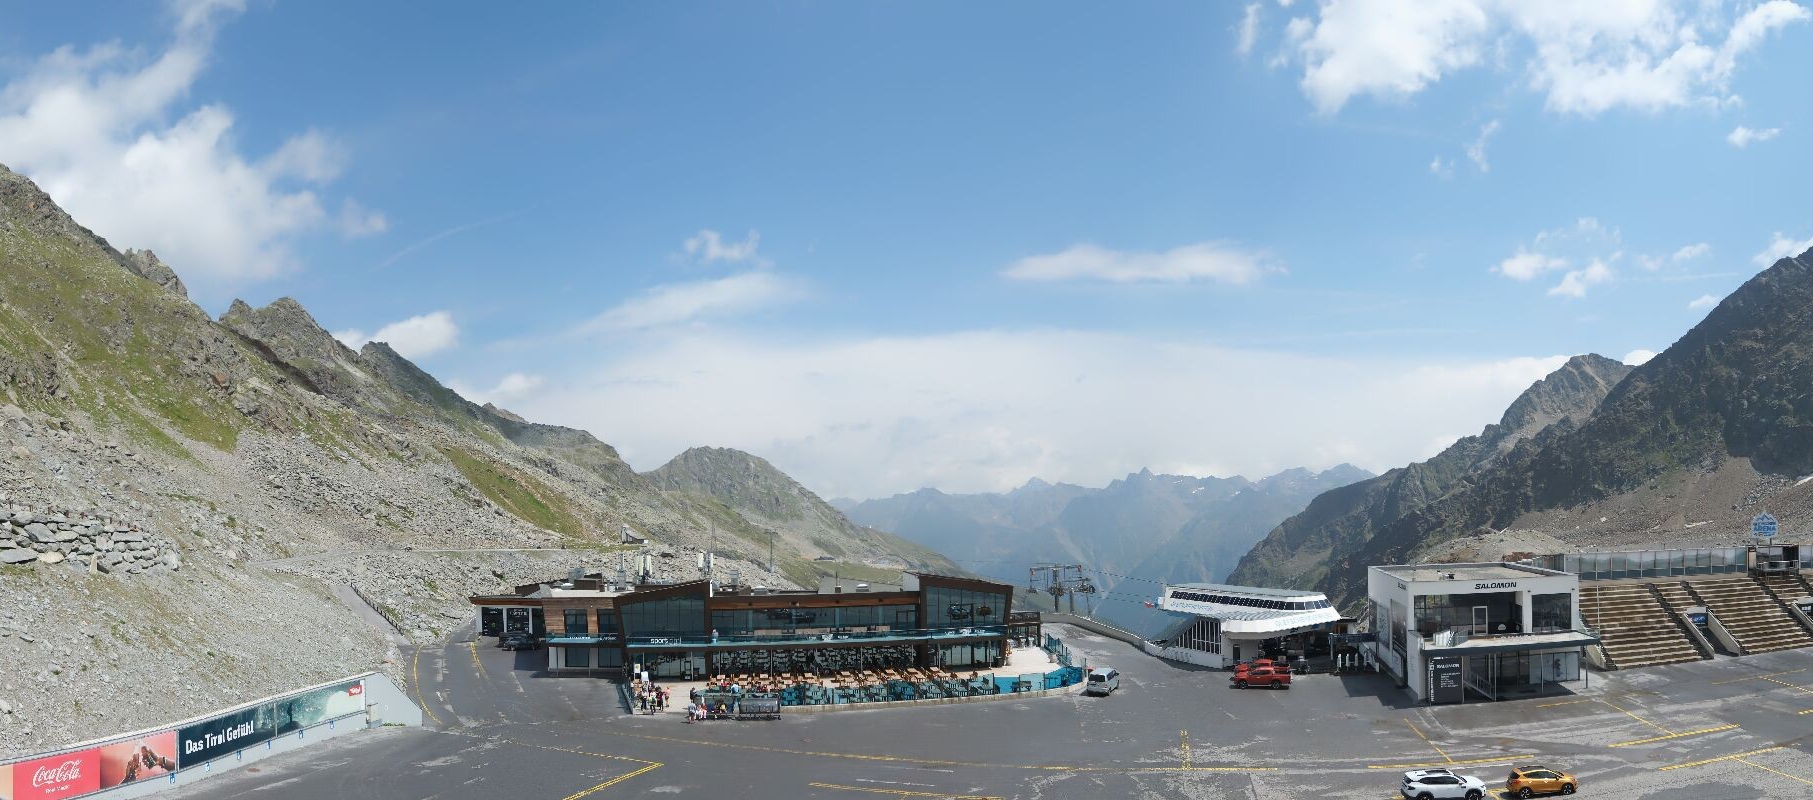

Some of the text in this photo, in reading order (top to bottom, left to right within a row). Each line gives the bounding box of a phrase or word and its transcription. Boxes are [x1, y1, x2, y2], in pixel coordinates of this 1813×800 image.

[1475, 582, 1517, 590] SALOMON
[185, 720, 255, 755] Das Tirol Gefühl
